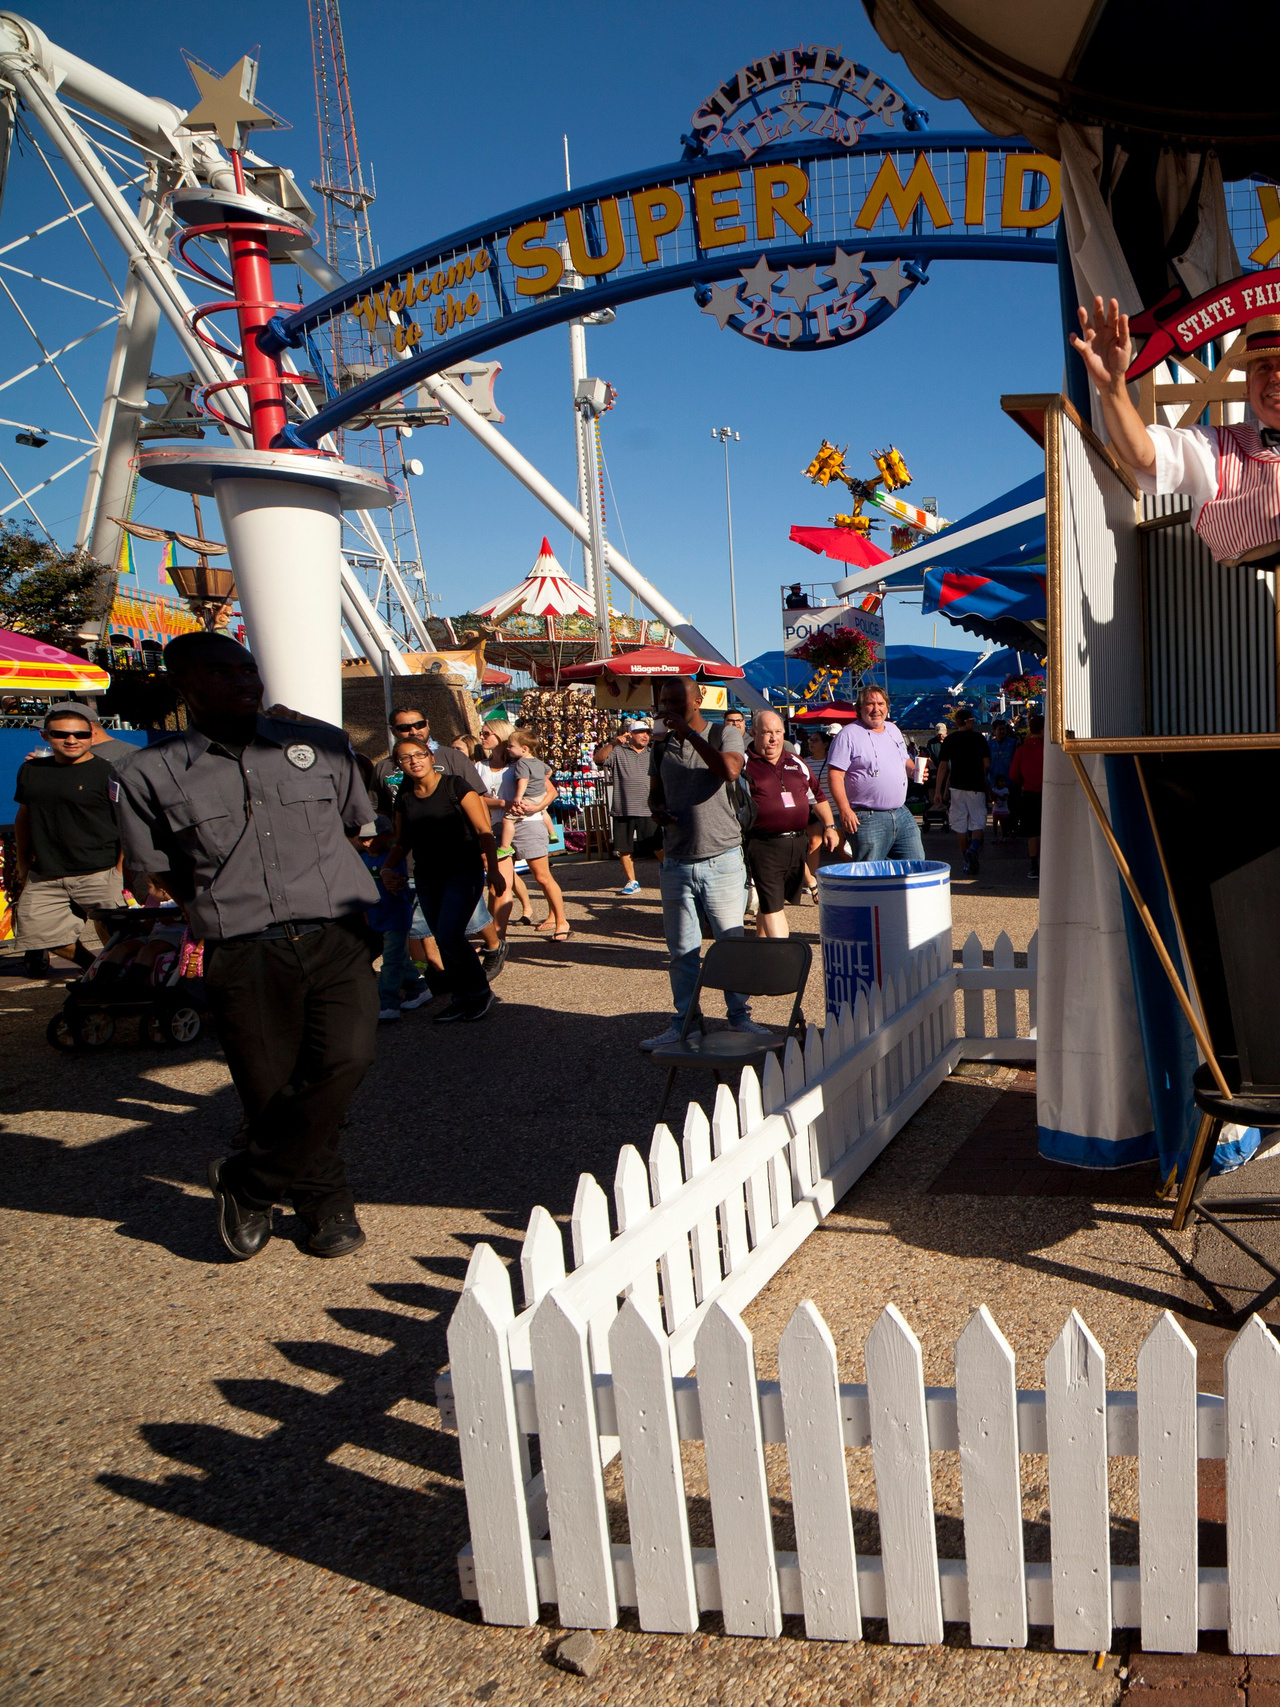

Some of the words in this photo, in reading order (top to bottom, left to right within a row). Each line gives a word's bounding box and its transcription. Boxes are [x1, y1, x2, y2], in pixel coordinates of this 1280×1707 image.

[691, 43, 806, 147] STATE
[807, 43, 904, 127] FAIR
[780, 80, 801, 103] of
[721, 102, 867, 162] TEXAS
[506, 163, 814, 297] SUPER
[353, 248, 492, 332] Welcome
[742, 292, 867, 348] 2013
[1177, 296, 1236, 343] STATE
[393, 322, 424, 352] to
[434, 292, 482, 335] the
[854, 616, 880, 637] POLICE
